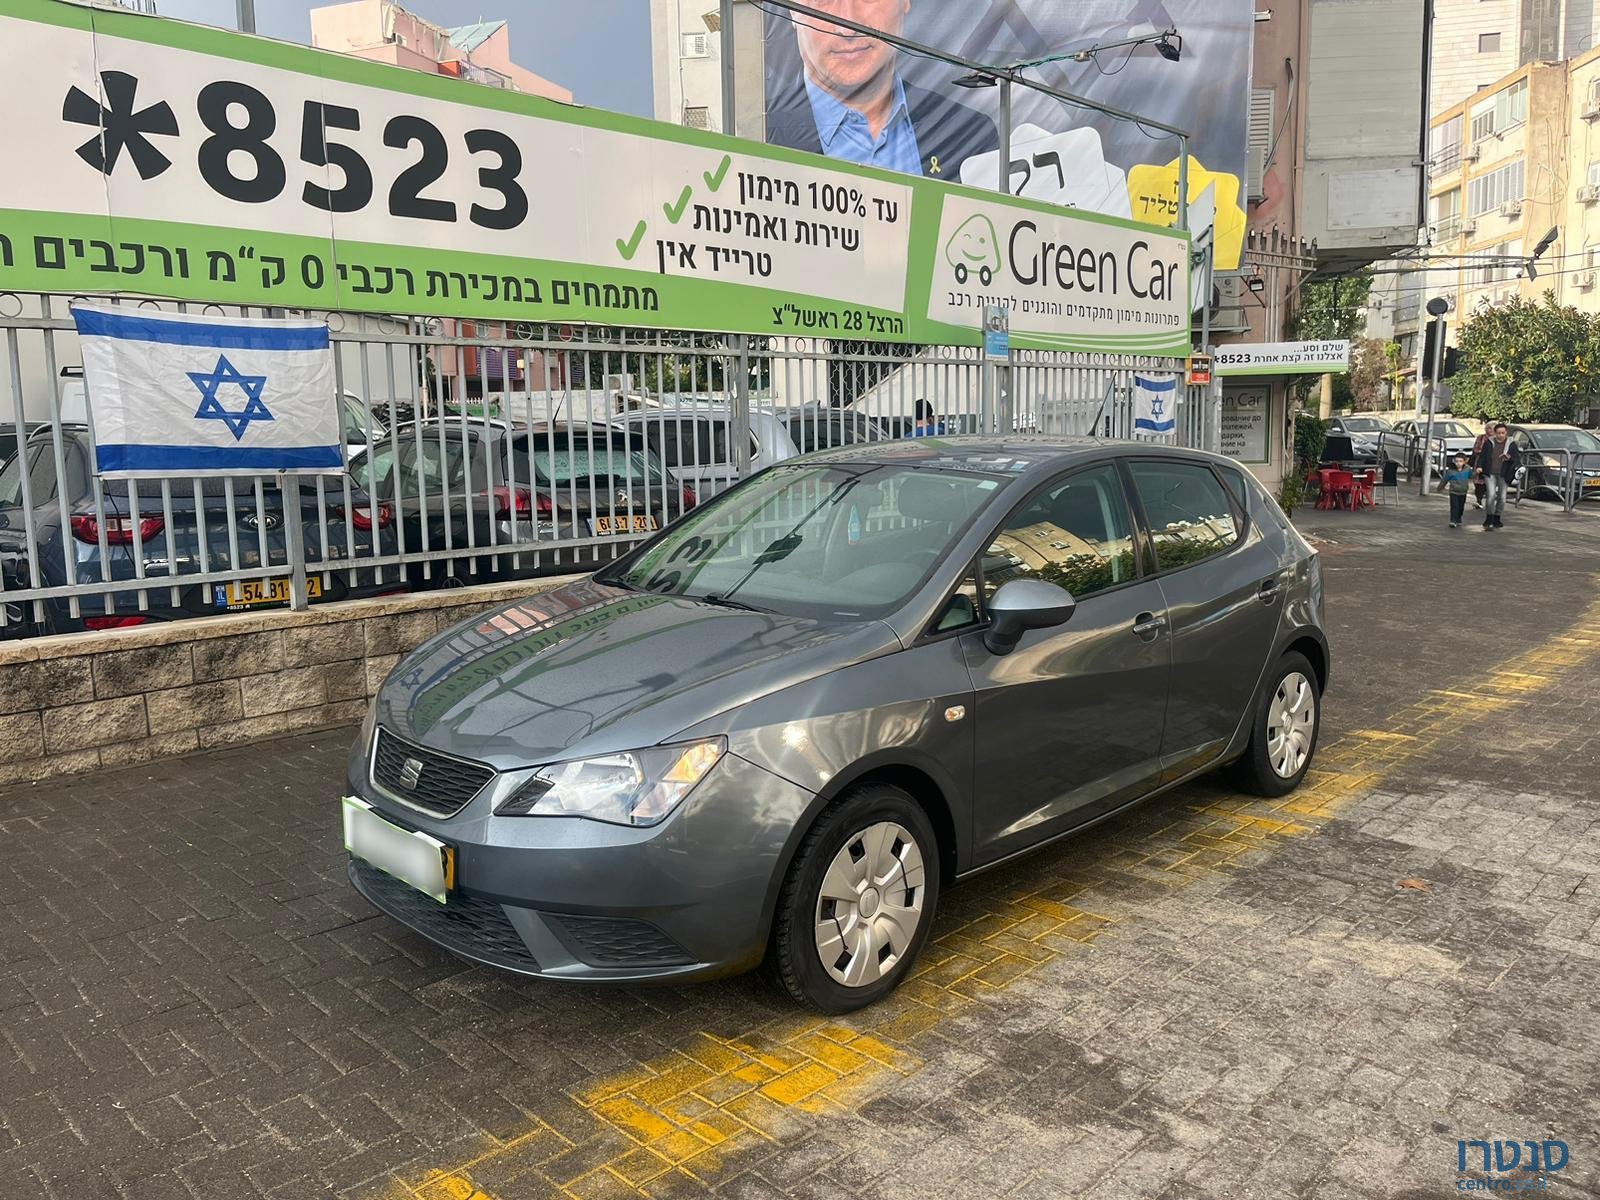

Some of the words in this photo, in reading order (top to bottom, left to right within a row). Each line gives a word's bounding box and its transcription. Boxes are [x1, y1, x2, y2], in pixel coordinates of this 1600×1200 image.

[738, 172, 800, 206] מימון
[808, 181, 867, 218] 100%
[872, 197, 898, 223] עד
[693, 204, 787, 242] ואמינות
[795, 220, 860, 251] שירות
[33, 235, 190, 279] ורכבים
[656, 240, 697, 274] אין
[705, 246, 772, 277] טרייד
[1008, 219, 1117, 295] Green
[1127, 240, 1178, 301] Car
[335, 264, 415, 295] רכבי
[426, 270, 543, 303] במכירת
[551, 280, 659, 311] מתמחים
[948, 291, 972, 307] רכב
[1022, 299, 1062, 315] והוגנים
[843, 310, 863, 331] 28
[867, 311, 904, 335] הרצל
[1066, 304, 1113, 322] מתקדמים
[1116, 308, 1142, 324] מימון
[1144, 311, 1180, 326] פתרונות
[1254, 355, 1278, 363] אחרת
[1281, 354, 1301, 363] קצת
[1303, 353, 1314, 361] זה
[1316, 352, 1343, 361] אצלנו
[1322, 343, 1344, 351] שלם
[1238, 392, 1262, 406] Car
